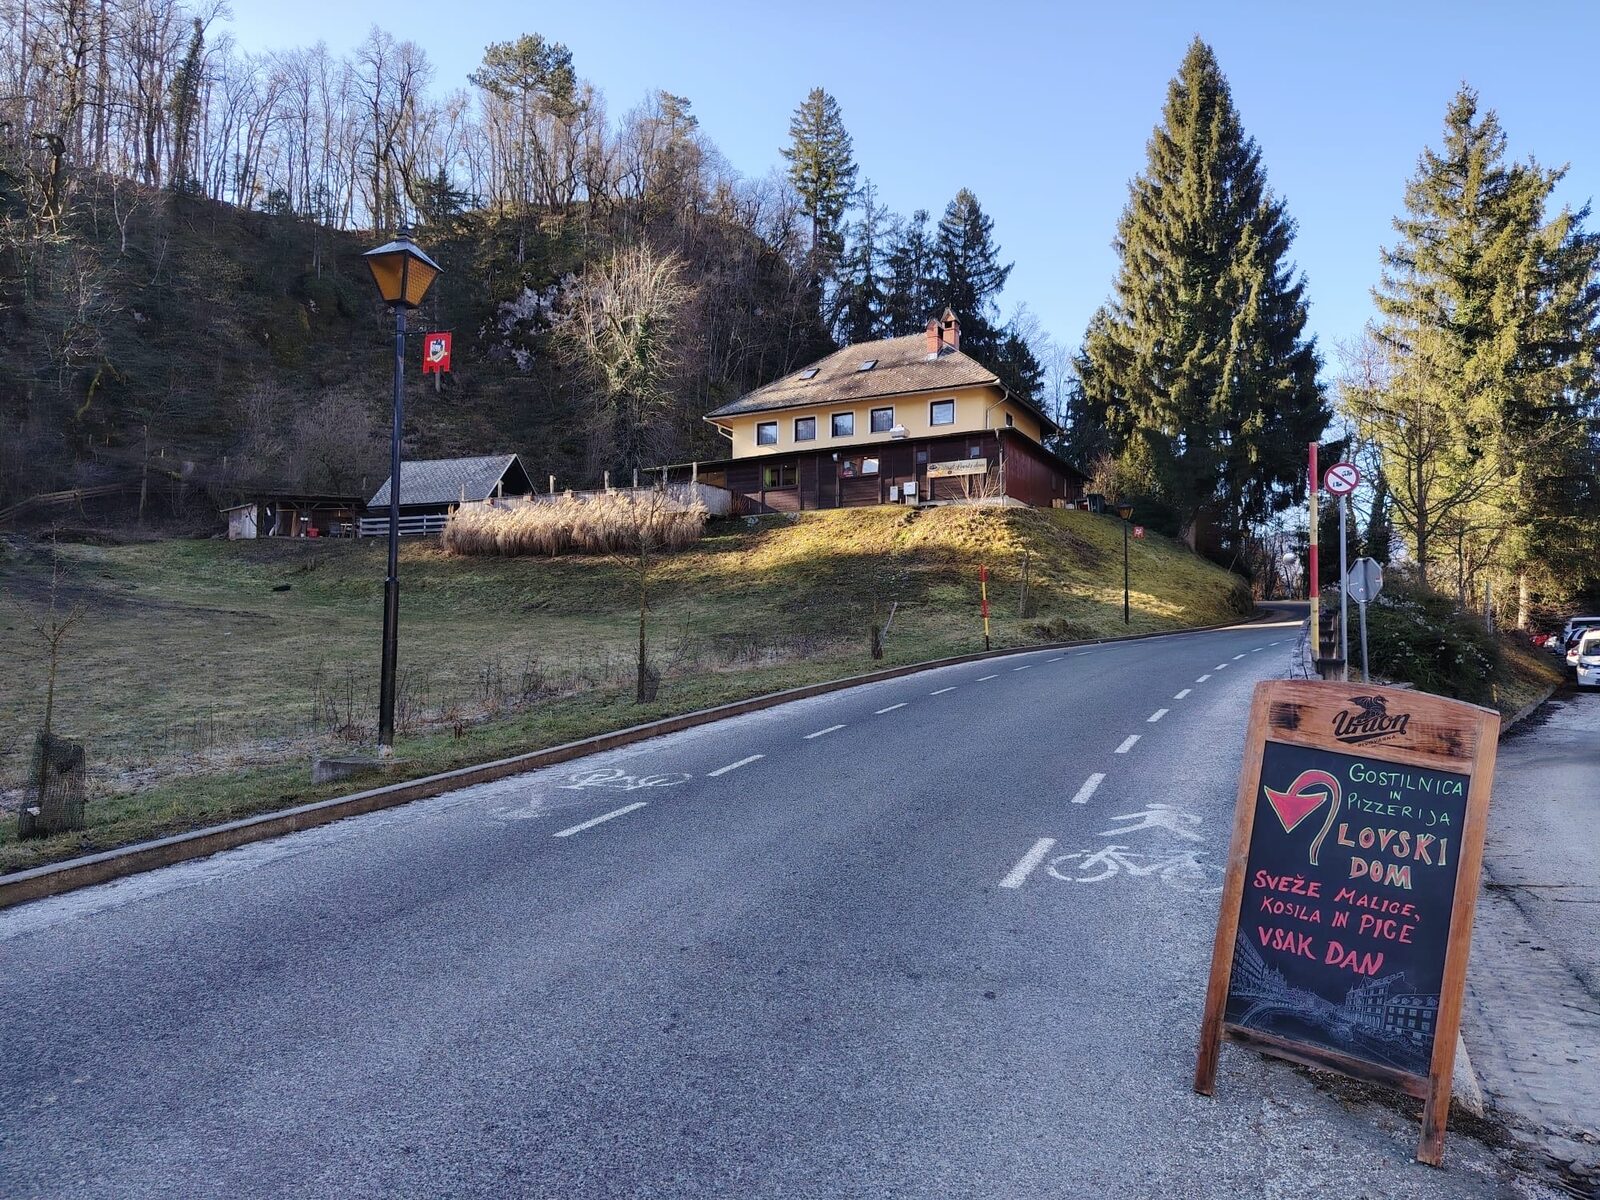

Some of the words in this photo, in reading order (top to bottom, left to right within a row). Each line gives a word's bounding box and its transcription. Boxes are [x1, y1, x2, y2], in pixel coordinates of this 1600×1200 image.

[1332, 710, 1411, 736] Union
[1349, 763, 1463, 796] GOSTILNICA
[1390, 791, 1402, 801] IN
[1348, 792, 1450, 826] PIZZERIJA
[1337, 823, 1447, 866] LOVSKI
[1349, 856, 1412, 890] DOM
[1253, 870, 1322, 898] SVEŽE
[1334, 887, 1422, 922] MALICE,
[1260, 896, 1321, 923] KOSILA
[1331, 911, 1350, 928] IN
[1358, 914, 1416, 944] PICE
[1258, 926, 1317, 960] VSAK
[1325, 941, 1384, 976] DAN
